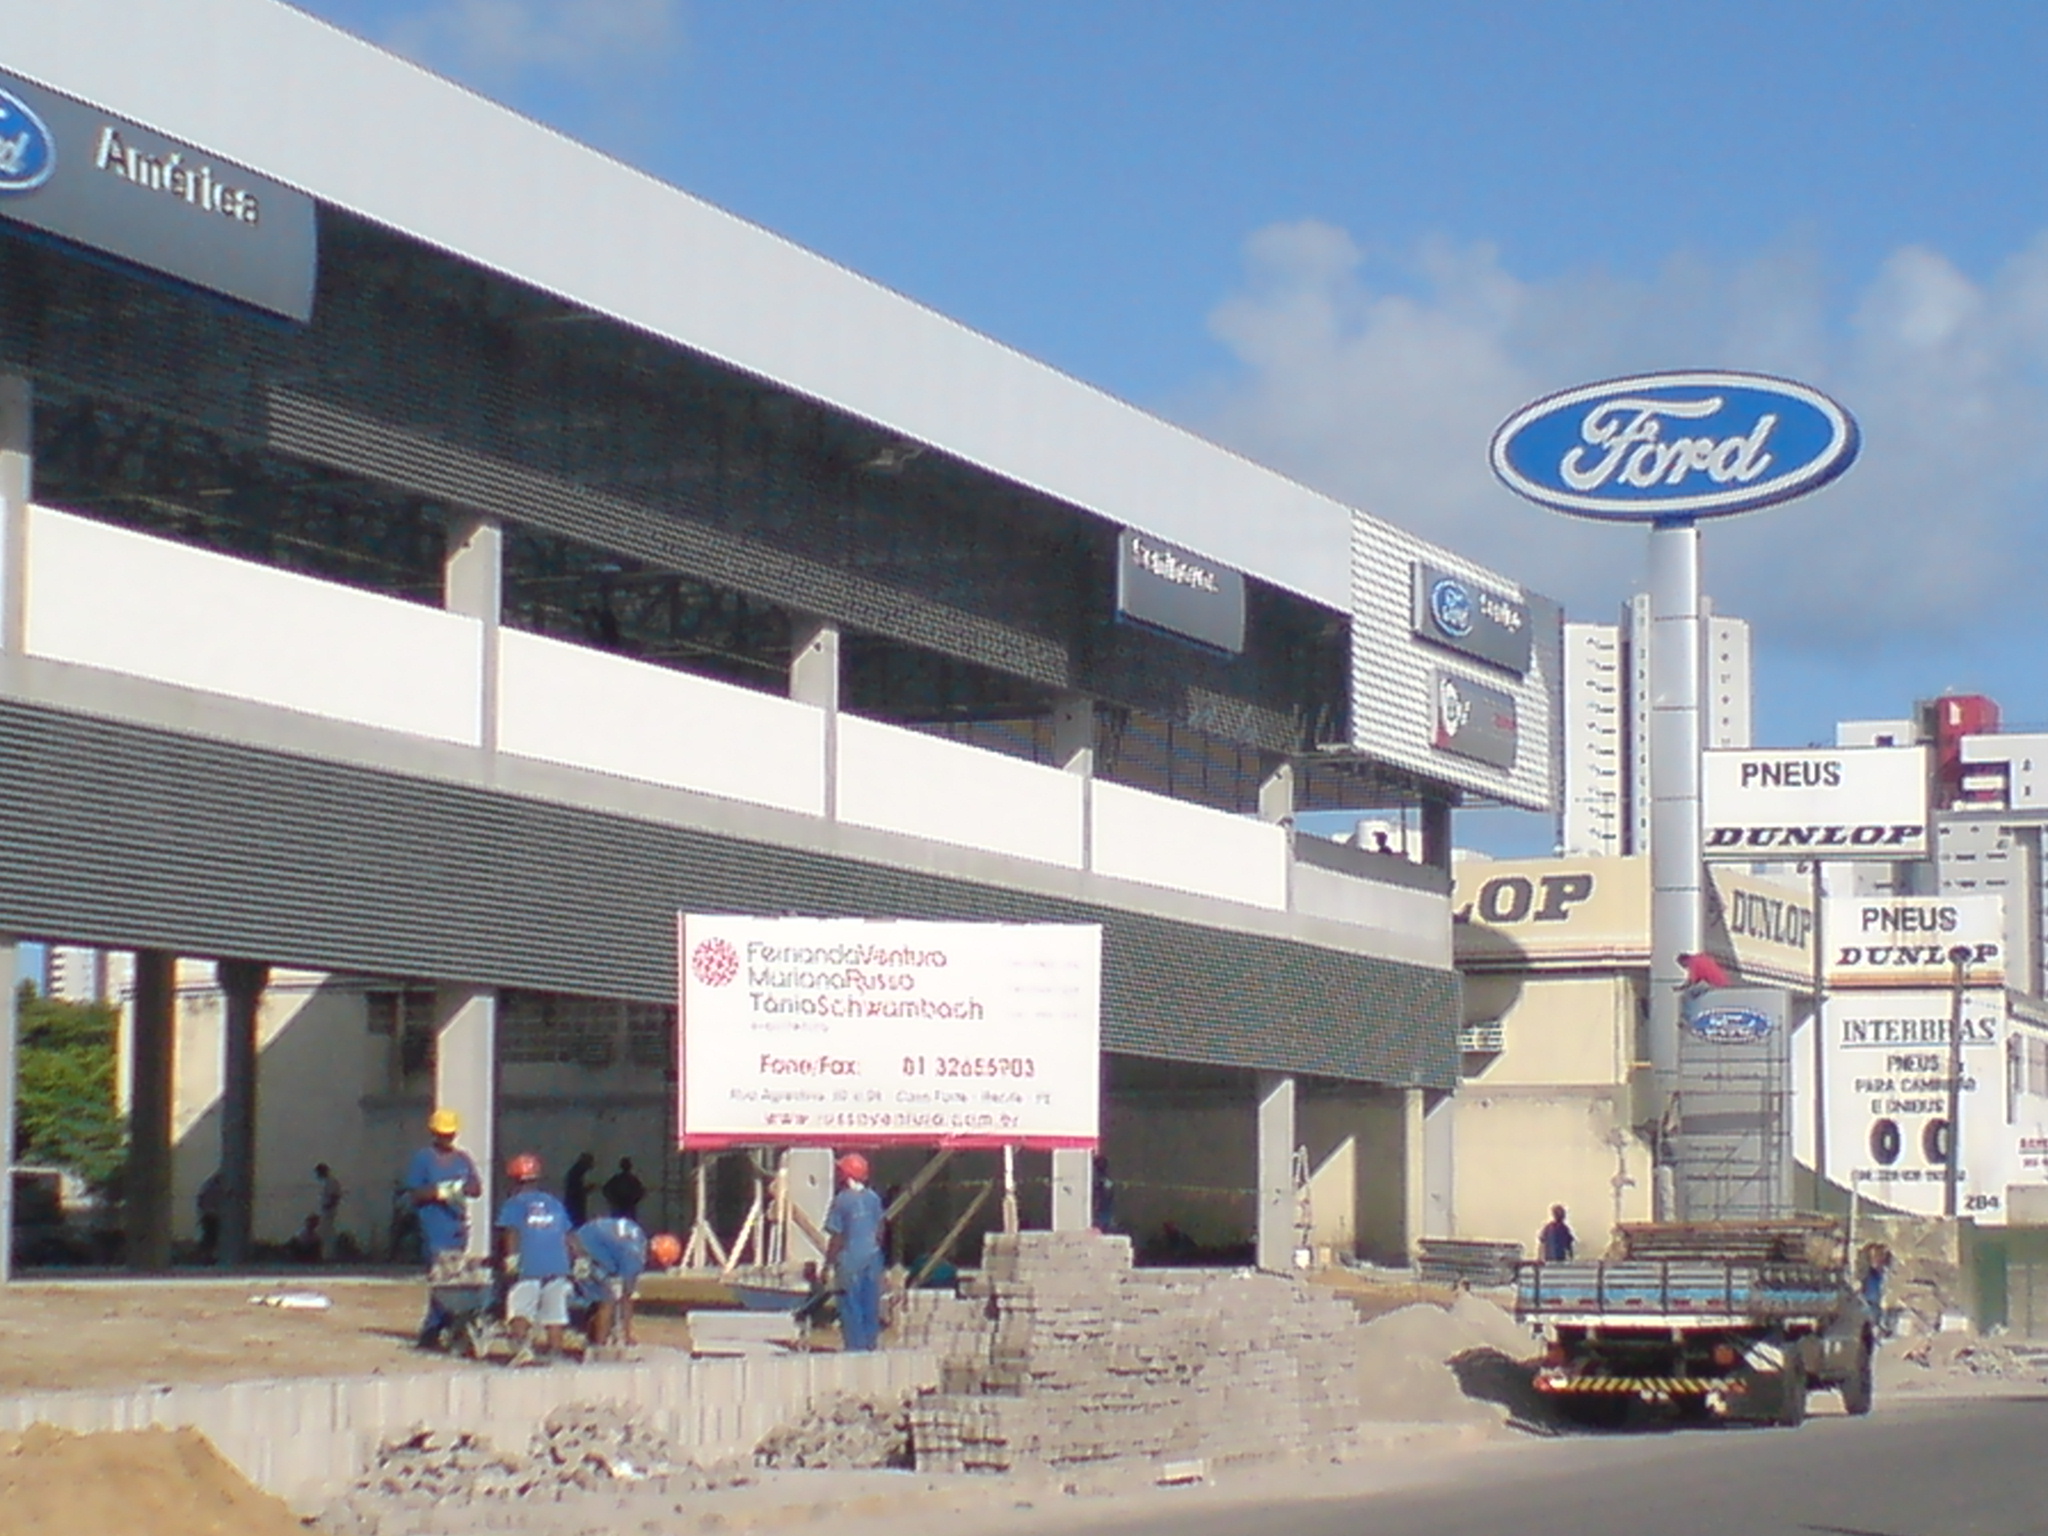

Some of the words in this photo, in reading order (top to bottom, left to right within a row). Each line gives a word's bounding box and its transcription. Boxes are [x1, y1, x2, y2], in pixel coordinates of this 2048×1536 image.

[98, 126, 260, 226] América
[1560, 396, 1778, 491] Ford
[1740, 761, 1842, 787] PNEUS
[1705, 825, 1924, 847] DUNLOP
[1730, 888, 1814, 949] DUNLOP
[1861, 907, 1959, 932] PNEUS
[1836, 943, 1999, 966] DUNLP
